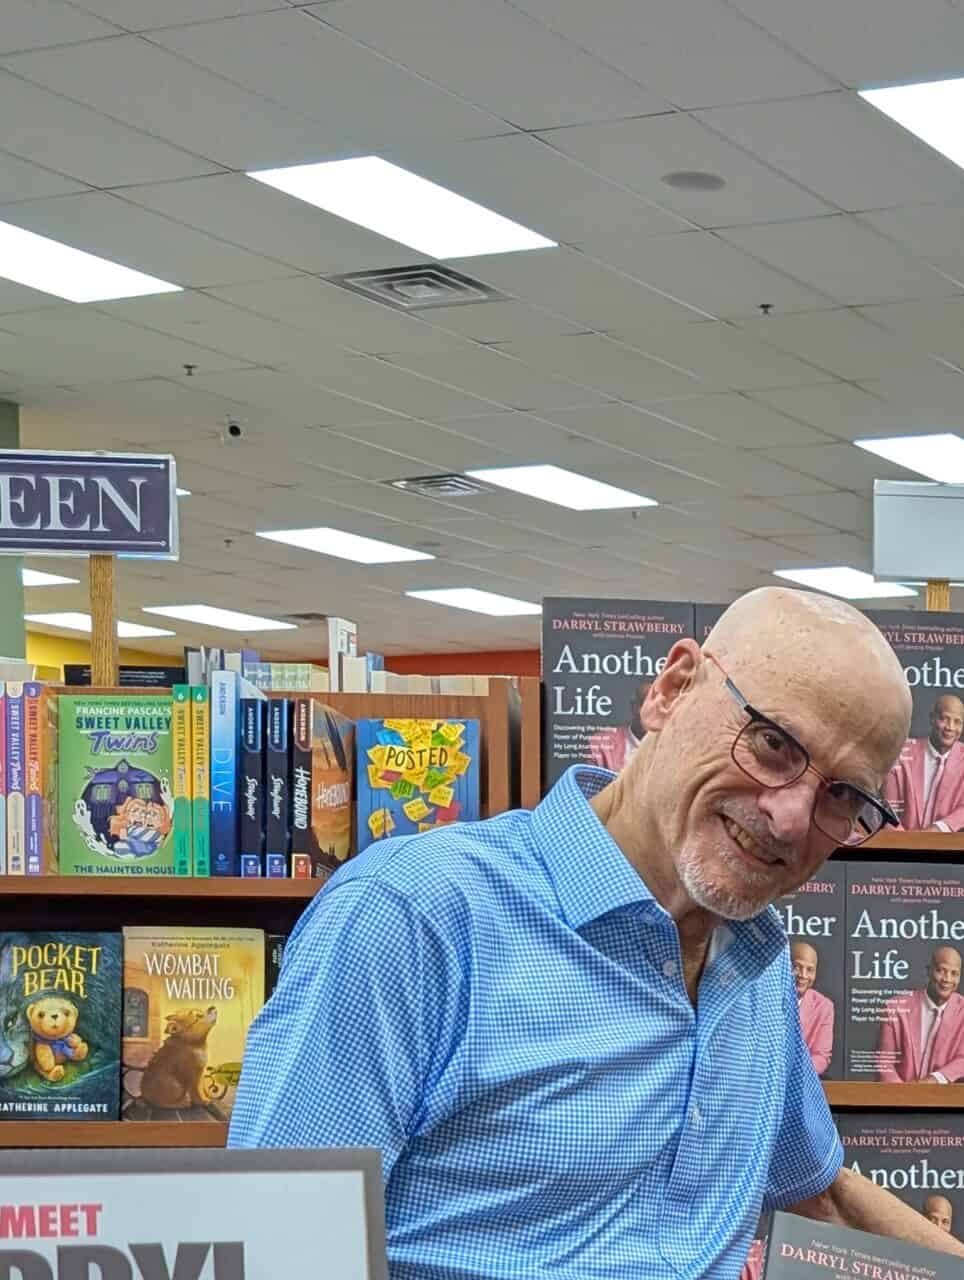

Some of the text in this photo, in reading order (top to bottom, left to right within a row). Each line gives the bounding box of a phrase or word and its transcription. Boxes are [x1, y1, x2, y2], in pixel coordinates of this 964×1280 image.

[553, 619, 685, 633] DARRYL STRAWBERRY
[76, 706, 125, 715] FRANCINE
[553, 685, 612, 716] Life
[76, 717, 172, 729] SWEET VALLEY
[87, 731, 160, 755] Twins
[386, 746, 448, 770] POSTED
[212, 747, 232, 813] DIVE
[74, 865, 175, 875] THE HAUNTED HOUS
[851, 884, 899, 895] DARRYL
[11, 942, 102, 978] POCKET
[145, 953, 221, 977] WOMBAT
[851, 950, 909, 980] Life
[24, 968, 88, 999] BEAR
[165, 977, 235, 1001] WAITING
[54, 1103, 108, 1113] APPLEGATE
[842, 1136, 889, 1146] DARRYL
[0, 1204, 102, 1239] MEET
[779, 1243, 849, 1277] DARRYL
